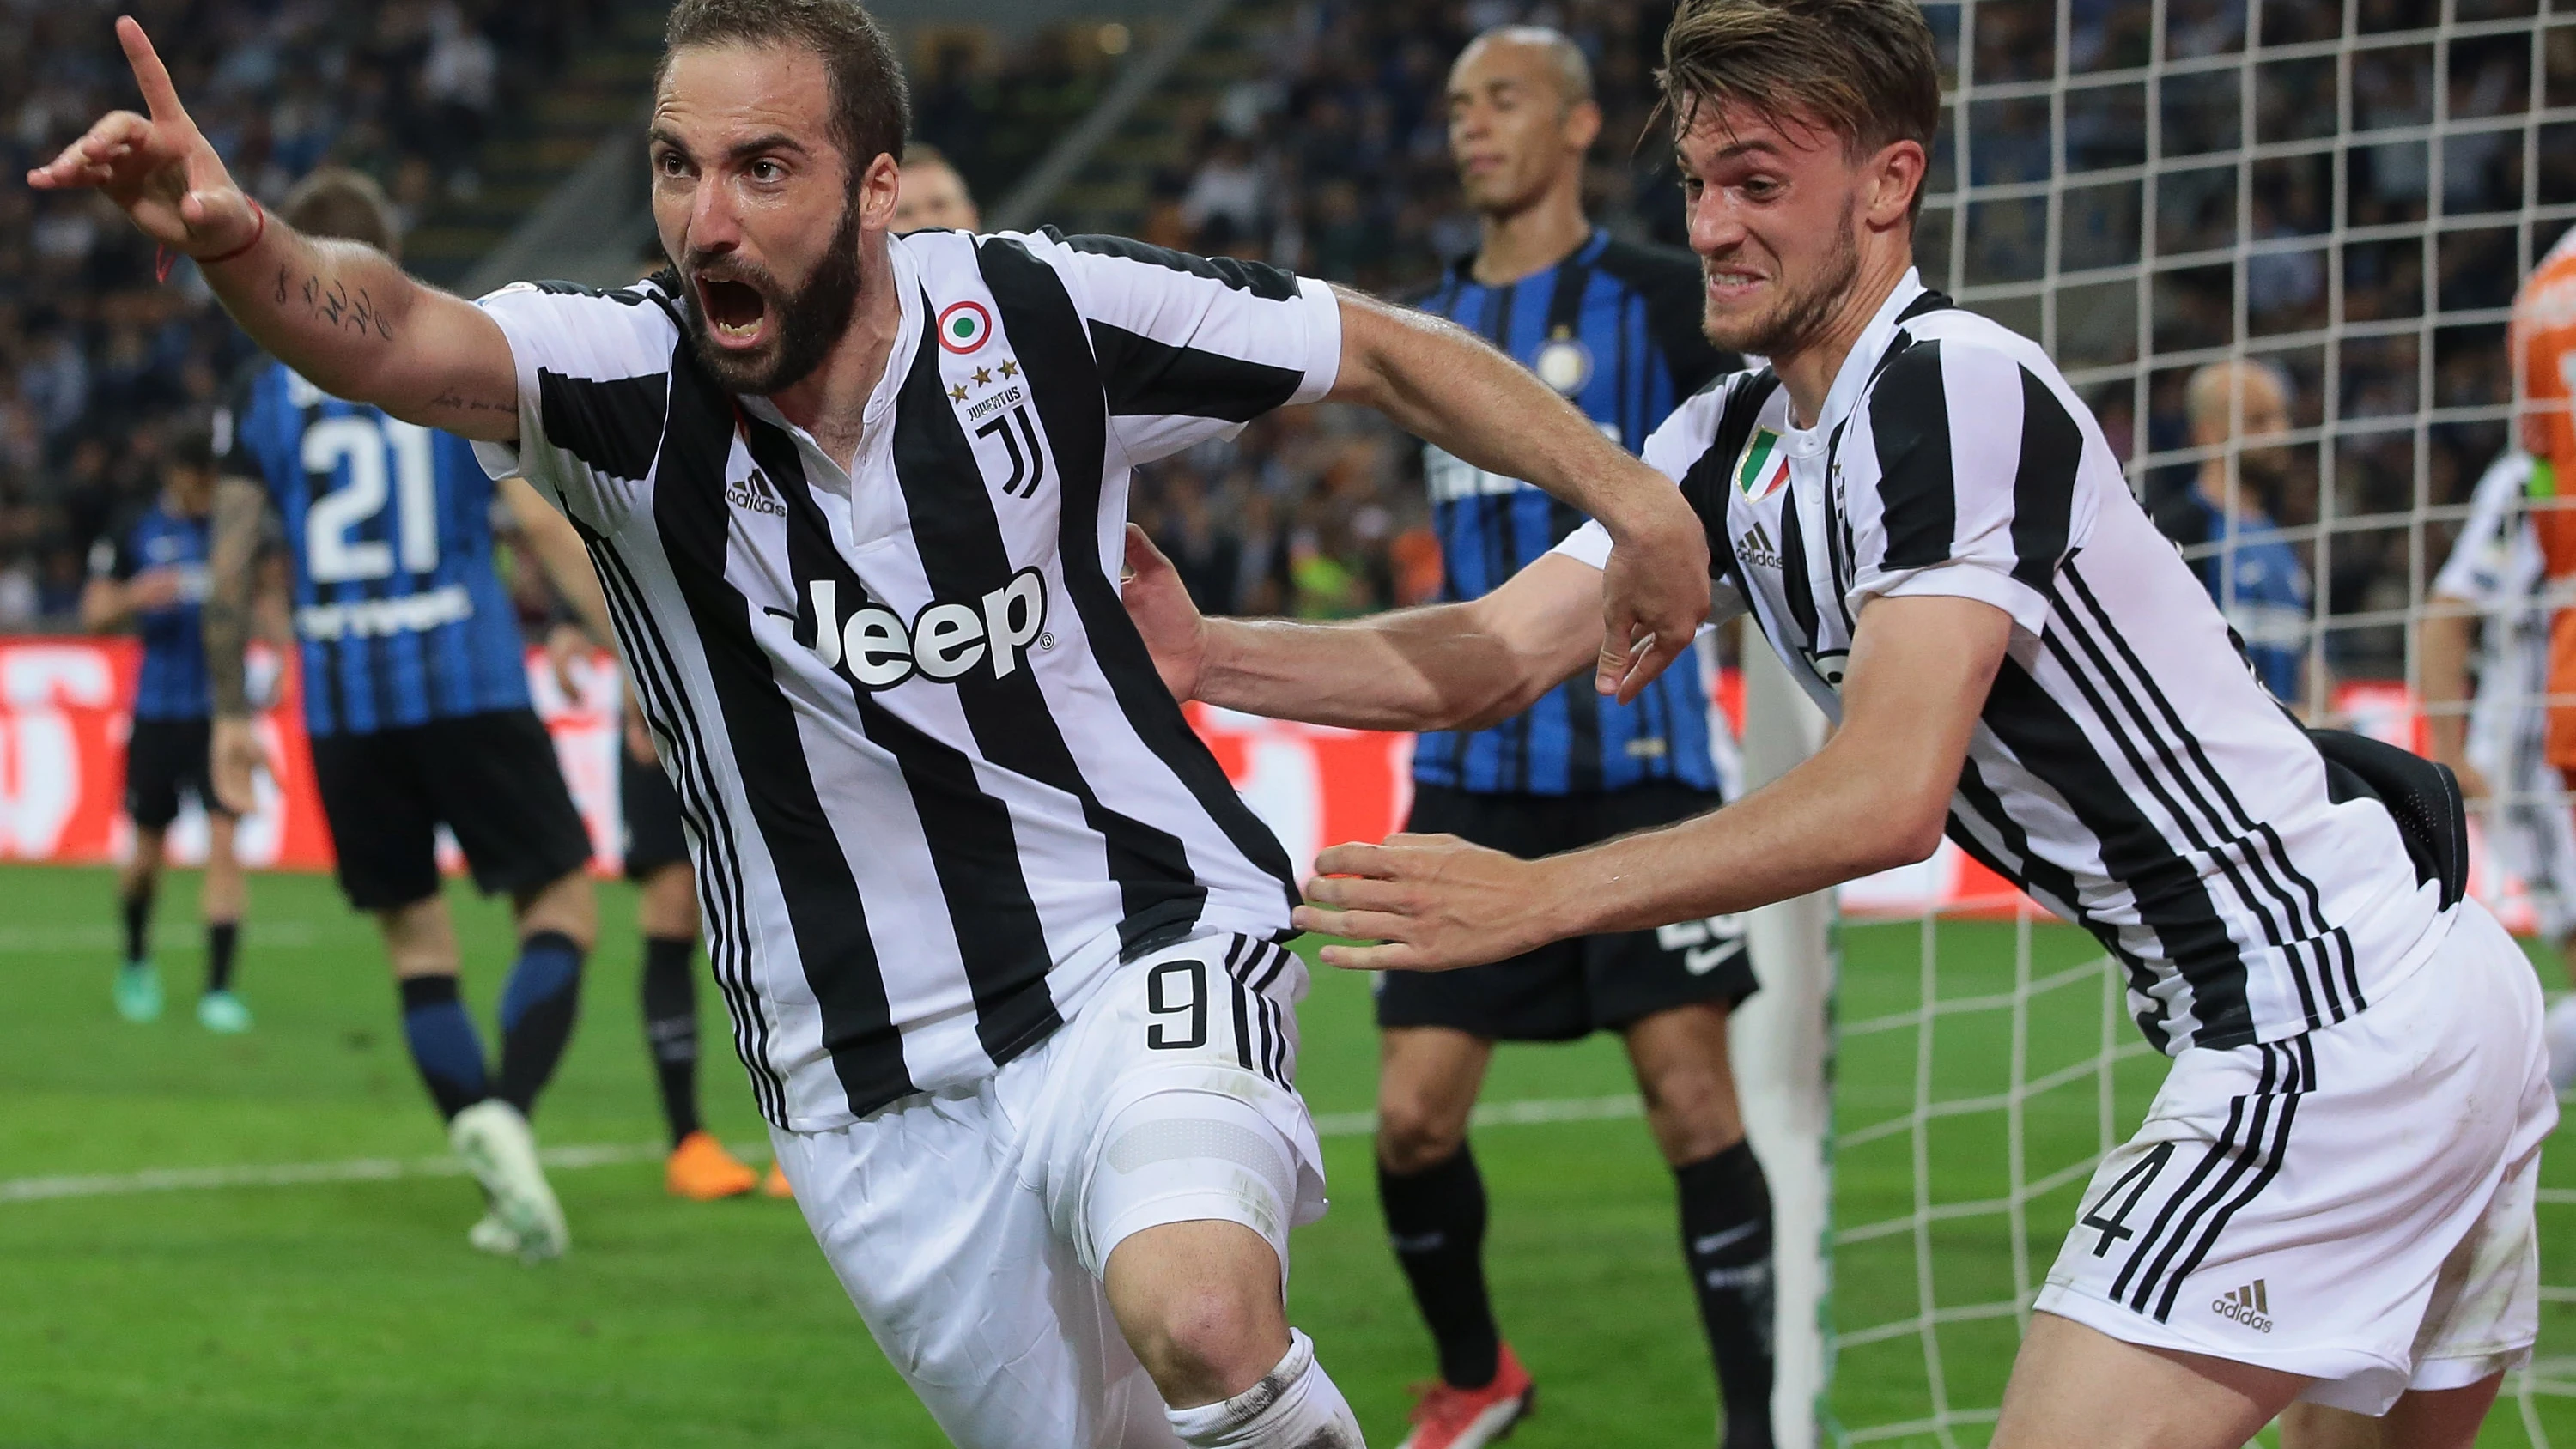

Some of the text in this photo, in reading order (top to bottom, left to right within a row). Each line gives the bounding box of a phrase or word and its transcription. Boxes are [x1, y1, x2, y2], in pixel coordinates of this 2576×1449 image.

[966, 386, 1022, 421] JUVENTUS
[301, 415, 440, 585] 21
[726, 488, 787, 518] adidas
[1736, 548, 1783, 570] adidas
[764, 568, 1046, 683] Jeep
[1146, 959, 1208, 1050] 9
[2080, 1140, 2177, 1258] 4
[2212, 1300, 2273, 1334] adidas
